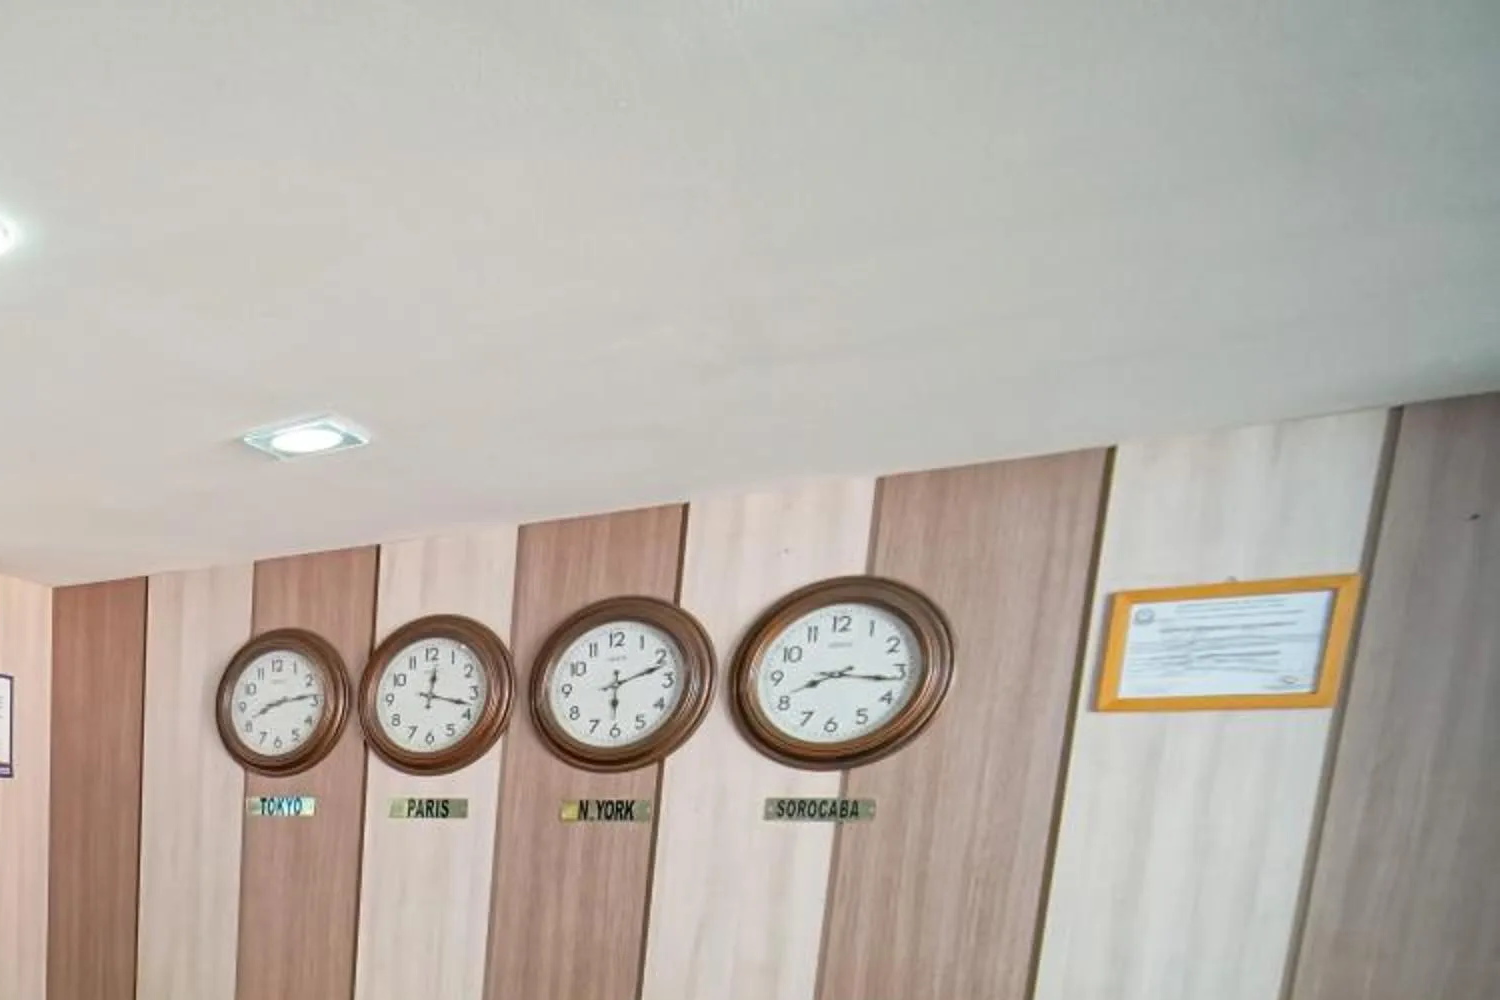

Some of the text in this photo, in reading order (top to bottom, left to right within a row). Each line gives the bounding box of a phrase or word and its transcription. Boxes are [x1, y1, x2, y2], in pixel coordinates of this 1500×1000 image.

[832, 615, 852, 633] 12
[869, 619, 876, 637] 1
[609, 631, 625, 648] 12
[807, 625, 819, 643] 11
[589, 642, 598, 659] 11
[640, 635, 644, 650] 1
[886, 636, 901, 654] 2
[425, 647, 439, 662] 12
[451, 650, 455, 665] 1
[655, 649, 667, 665] 2
[783, 645, 803, 663] 10
[464, 663, 474, 678] 2
[570, 661, 587, 677] 10
[892, 663, 907, 680] 3
[393, 673, 407, 687] 10
[661, 671, 674, 689] 3
[770, 670, 784, 687] 9
[468, 685, 479, 701] 3
[561, 683, 573, 698] 9
[878, 690, 893, 704] 4
[385, 693, 395, 706] 9
[652, 696, 665, 711] 4
[777, 695, 791, 711] 8
[391, 713, 401, 727] 8
[461, 708, 471, 720] 4
[569, 706, 580, 720] 8
[635, 713, 646, 729] 5
[800, 711, 814, 727] 7
[856, 708, 869, 725] 5
[408, 725, 418, 739] 7
[444, 723, 456, 737] 5
[589, 720, 600, 734] 7
[609, 723, 621, 738] 6
[823, 716, 838, 733] 6
[425, 731, 435, 745] 6
[259, 798, 302, 816] TOKYO
[407, 799, 450, 819] PARIS
[776, 799, 860, 819] SOROCABA
